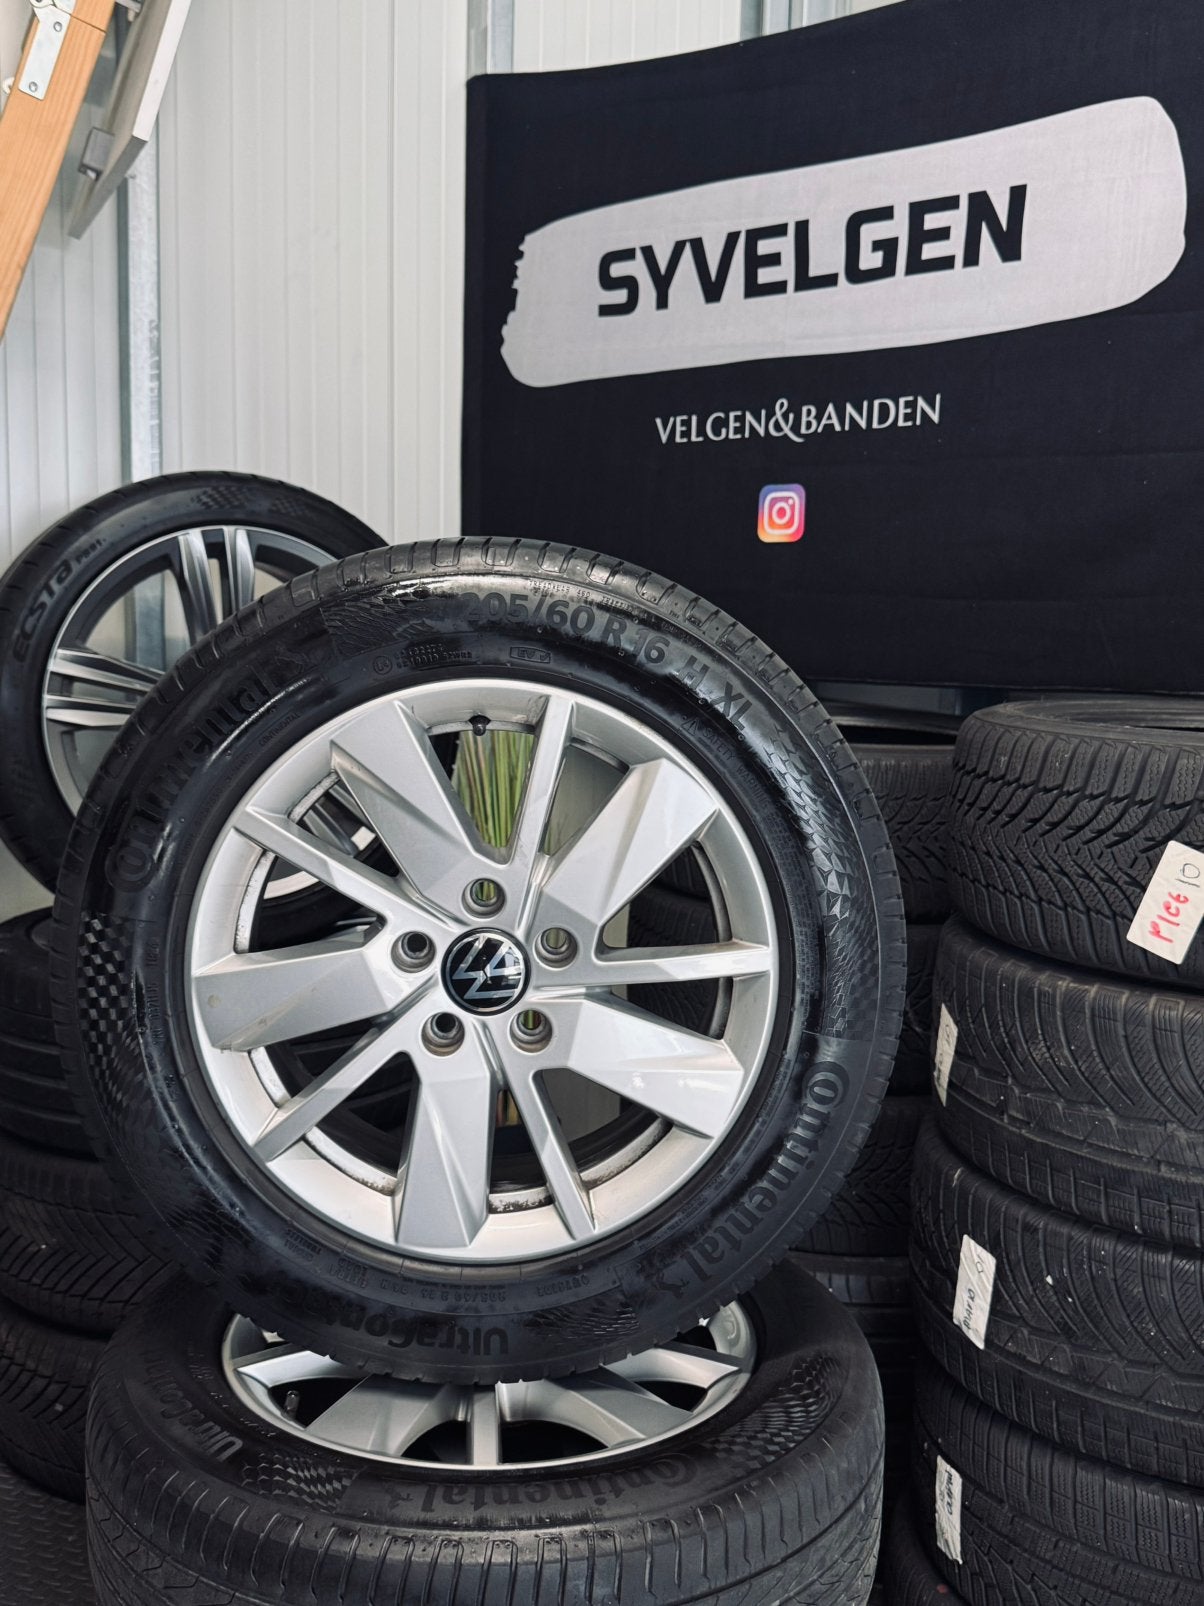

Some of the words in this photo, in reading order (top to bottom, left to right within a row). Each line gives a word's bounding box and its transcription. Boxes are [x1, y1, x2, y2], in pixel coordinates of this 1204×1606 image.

[597, 183, 1028, 317] SYVELGEN
[655, 394, 942, 444] VELGEN&BANDEN
[461, 589, 598, 638] 205/60
[603, 614, 629, 646] R
[632, 626, 671, 666] 16
[675, 655, 710, 688] H
[711, 683, 756, 733] XL
[685, 1060, 851, 1284] Continental
[422, 1452, 699, 1513] Continental
